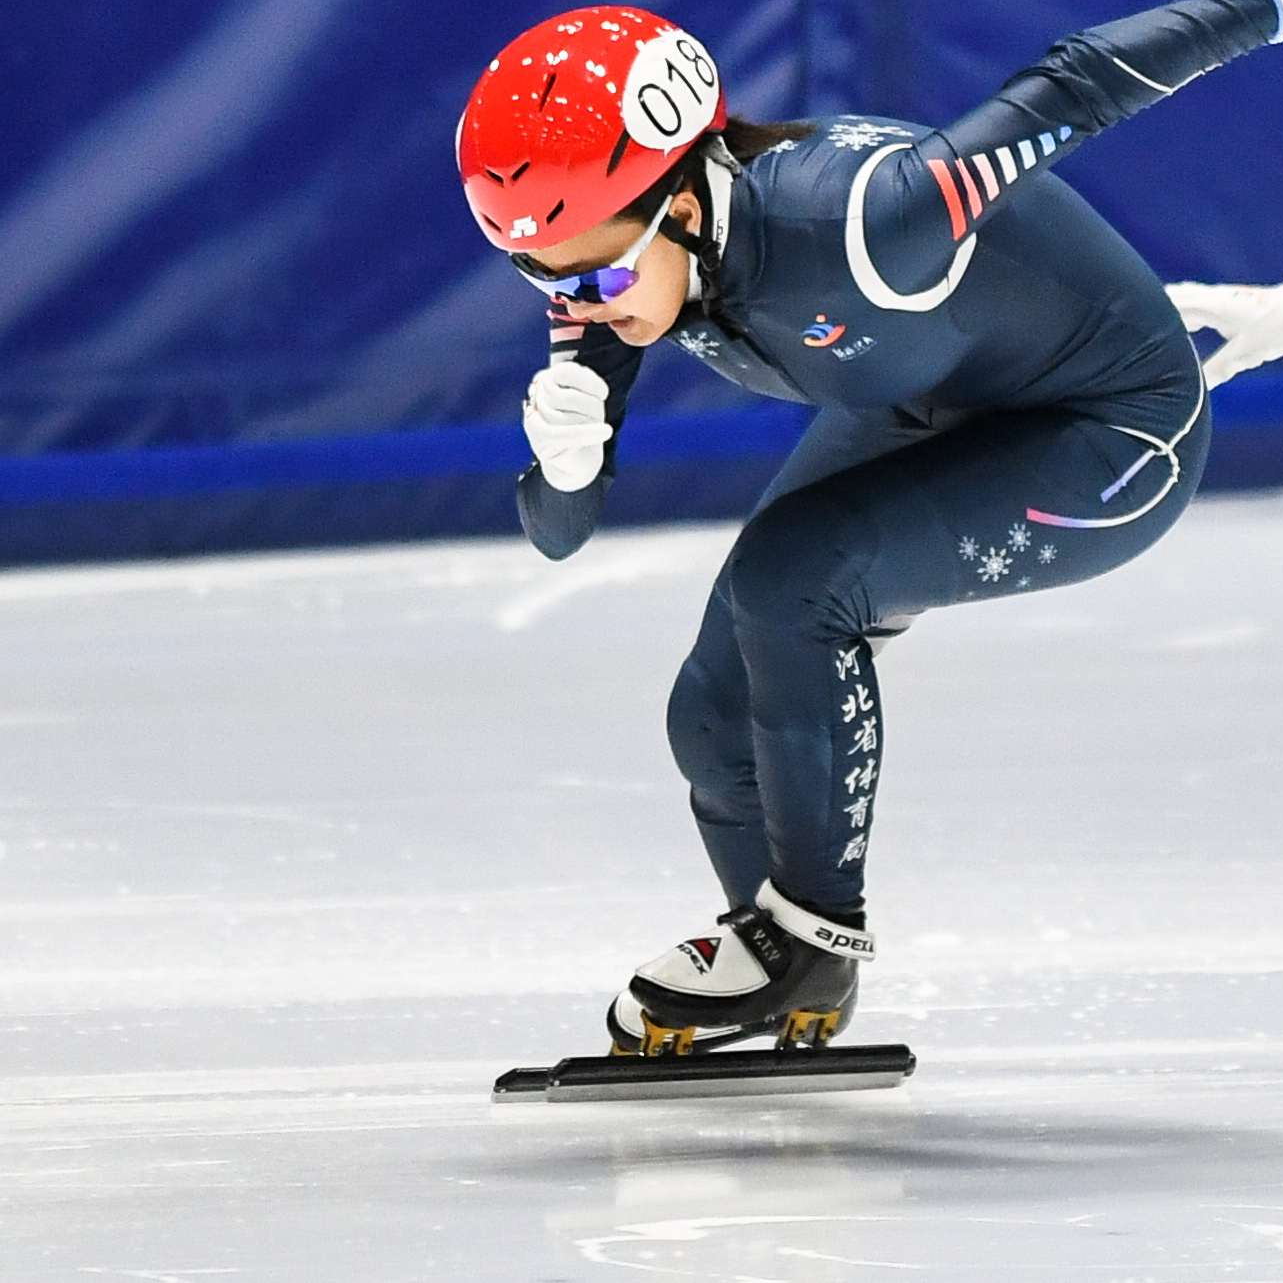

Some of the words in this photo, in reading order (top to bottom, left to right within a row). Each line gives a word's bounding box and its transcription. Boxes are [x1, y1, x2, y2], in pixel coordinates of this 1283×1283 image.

[638, 39, 715, 137] 018
[835, 644, 879, 868] 河北省体育局
